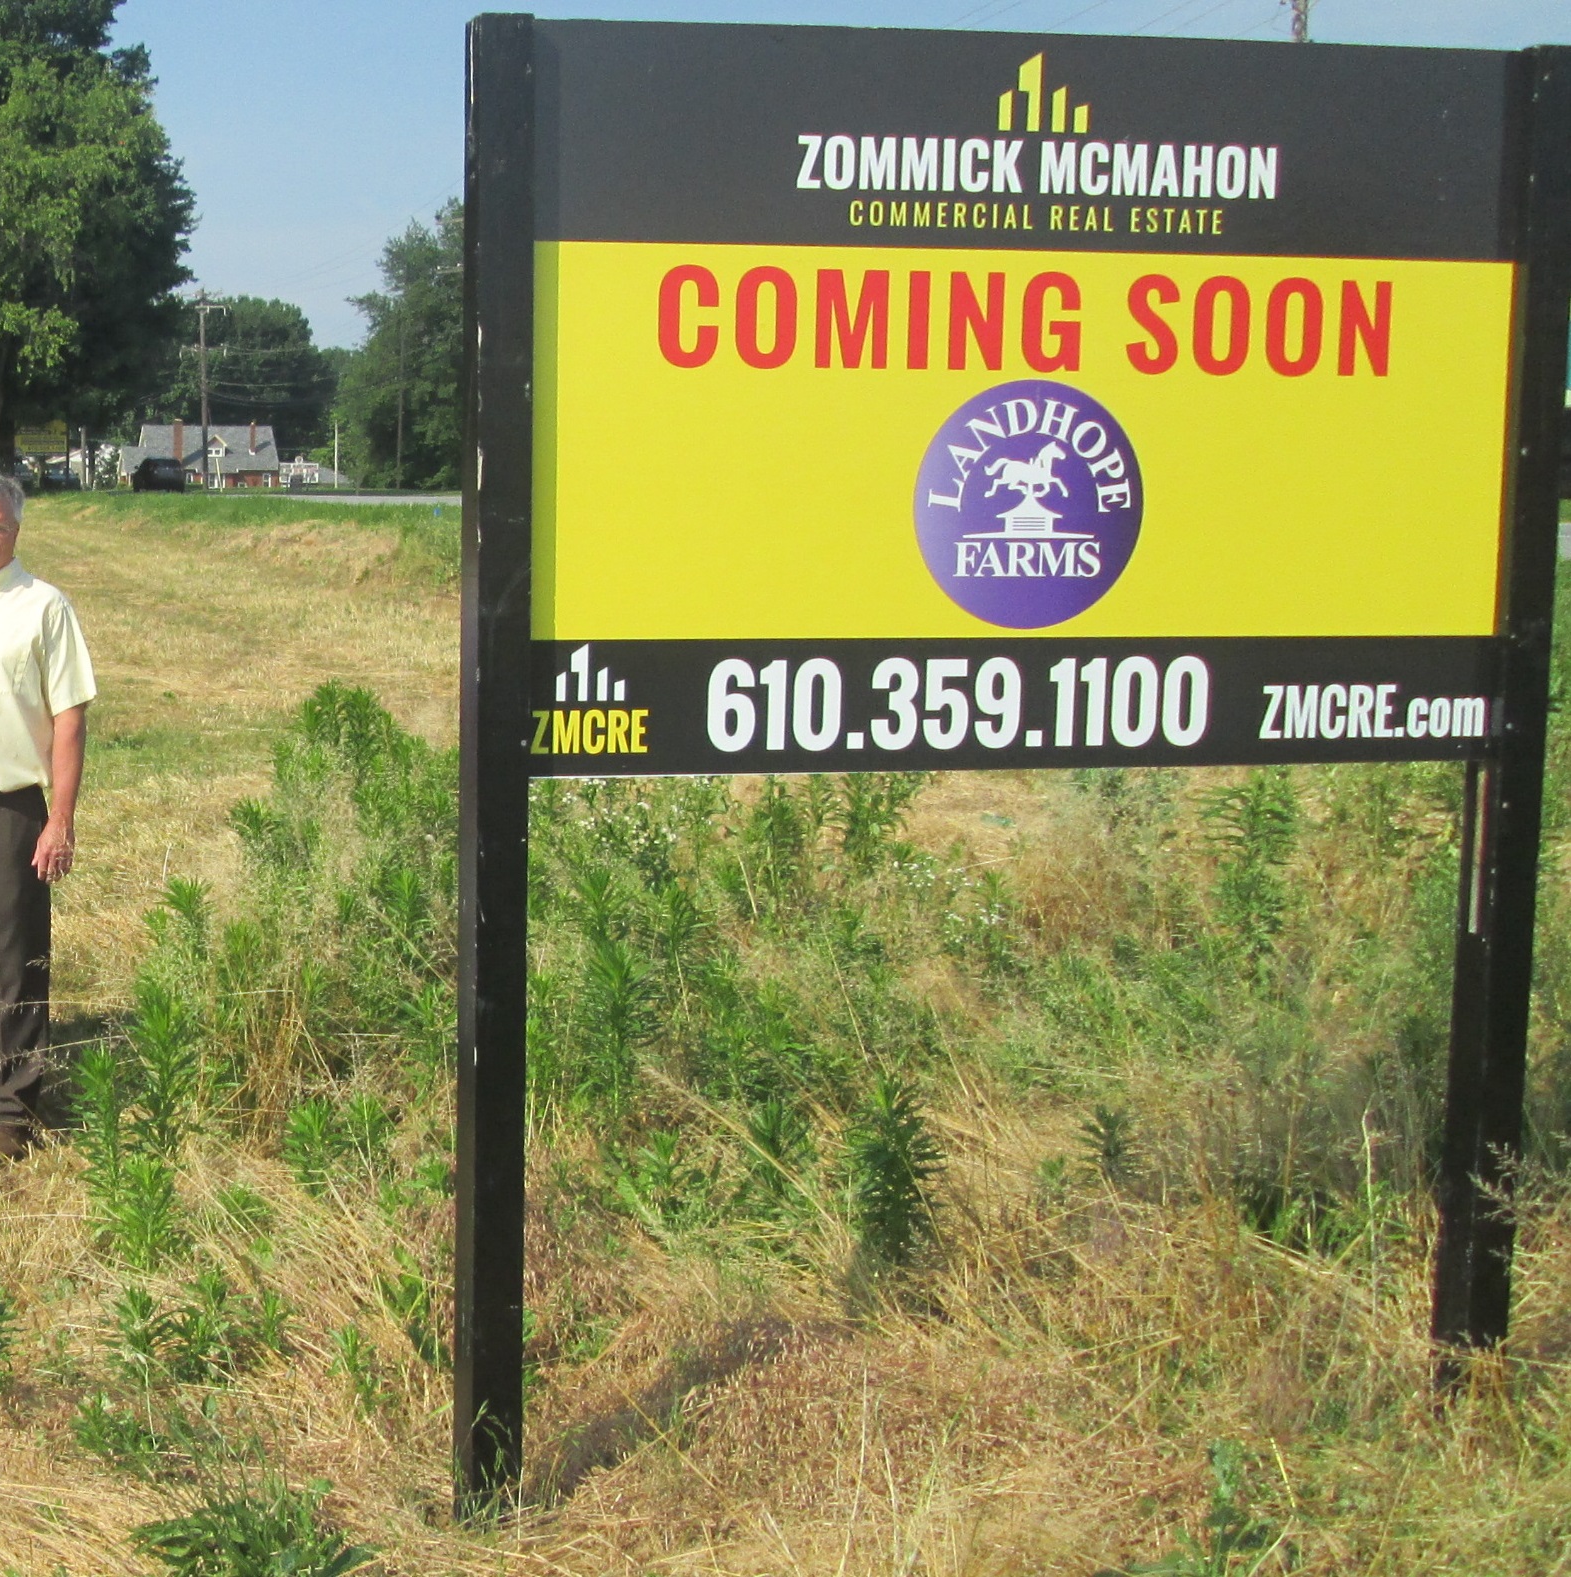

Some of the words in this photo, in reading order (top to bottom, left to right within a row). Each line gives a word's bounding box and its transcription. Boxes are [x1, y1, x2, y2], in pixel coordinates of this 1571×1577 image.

[796, 134, 1024, 193] ZOMMICK
[1039, 140, 1278, 199] MCMAHON
[849, 200, 1033, 230] COMMERCIAL
[1049, 204, 1114, 232] REAL
[1130, 207, 1223, 235] ESTATE
[657, 264, 1083, 372] COMING
[1126, 274, 1394, 377] SOON
[927, 398, 1132, 513] LANDHOPE
[952, 541, 1102, 578] FARMS
[530, 708, 649, 755] ZMCRE
[706, 657, 1209, 753] 610.359.1100
[1258, 684, 1485, 740] ZMCRE.com
